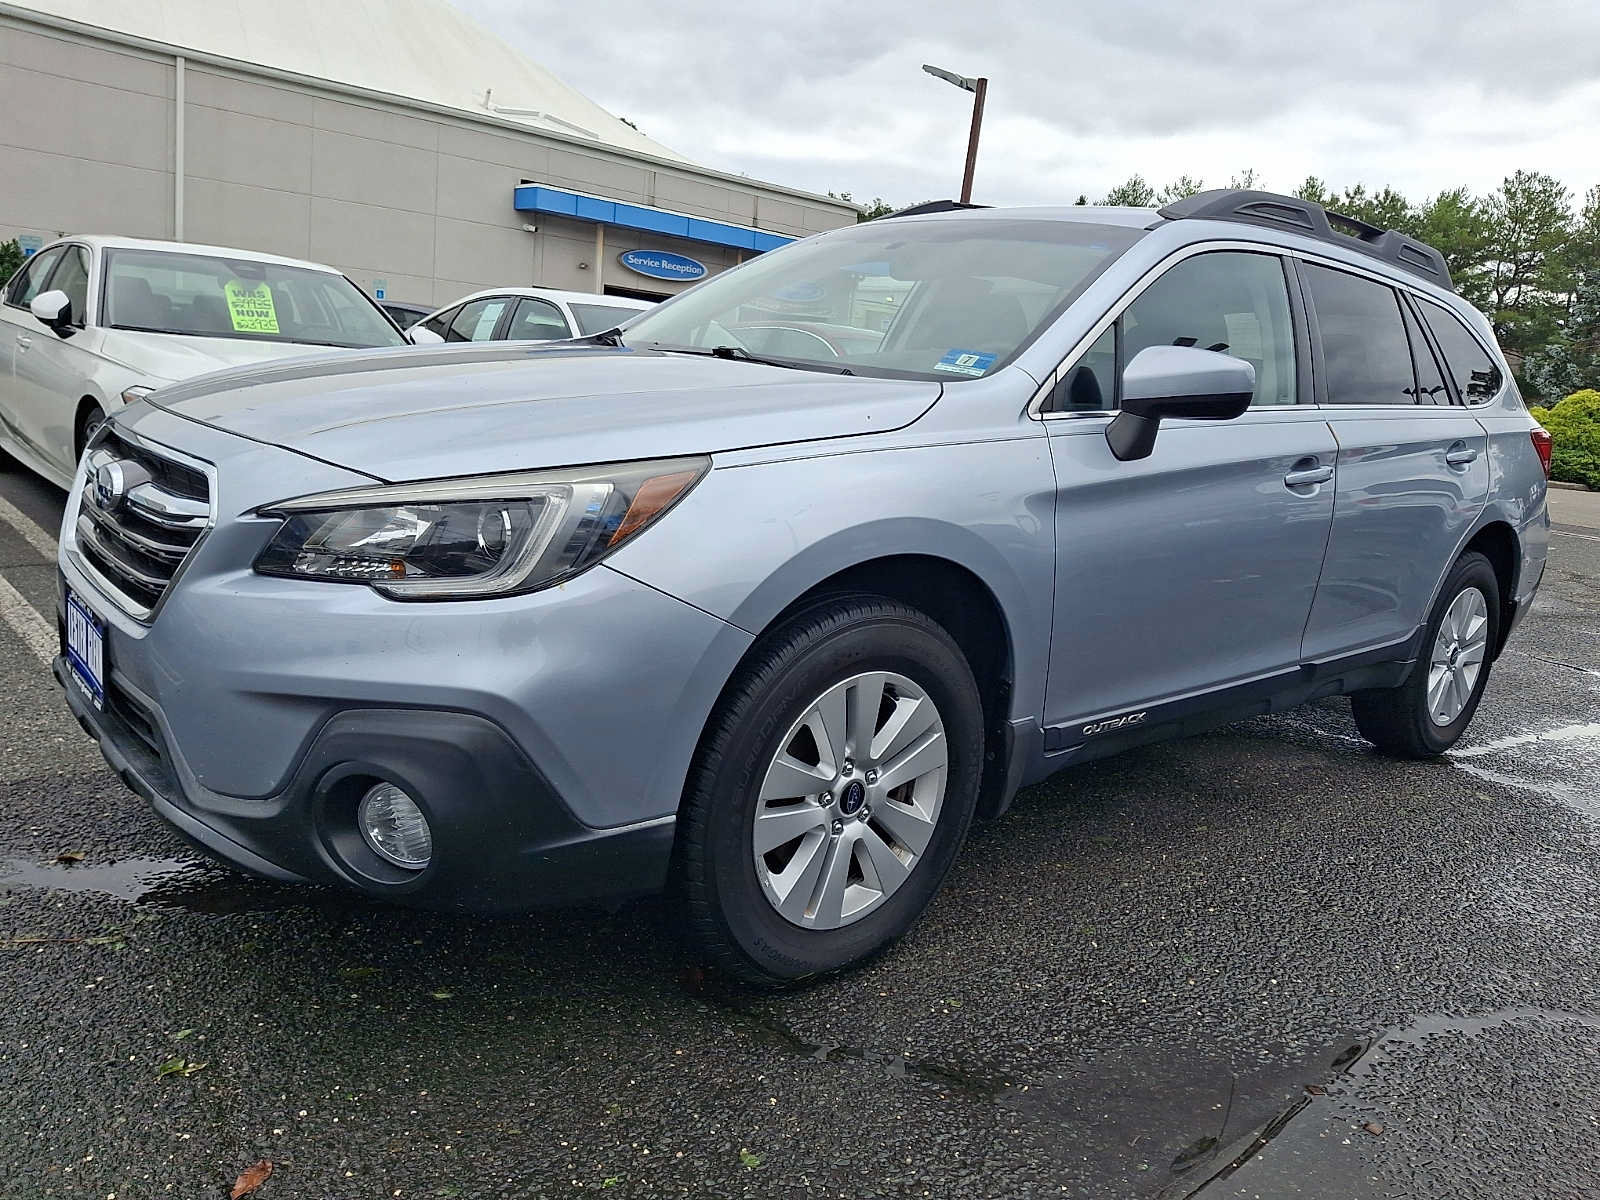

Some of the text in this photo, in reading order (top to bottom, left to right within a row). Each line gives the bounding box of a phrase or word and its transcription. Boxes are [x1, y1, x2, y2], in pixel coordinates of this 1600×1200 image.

[628, 254, 702, 274] Service Reception
[231, 289, 266, 299] WAS
[235, 309, 270, 318] NOW
[1082, 711, 1147, 735] OUTBACK
